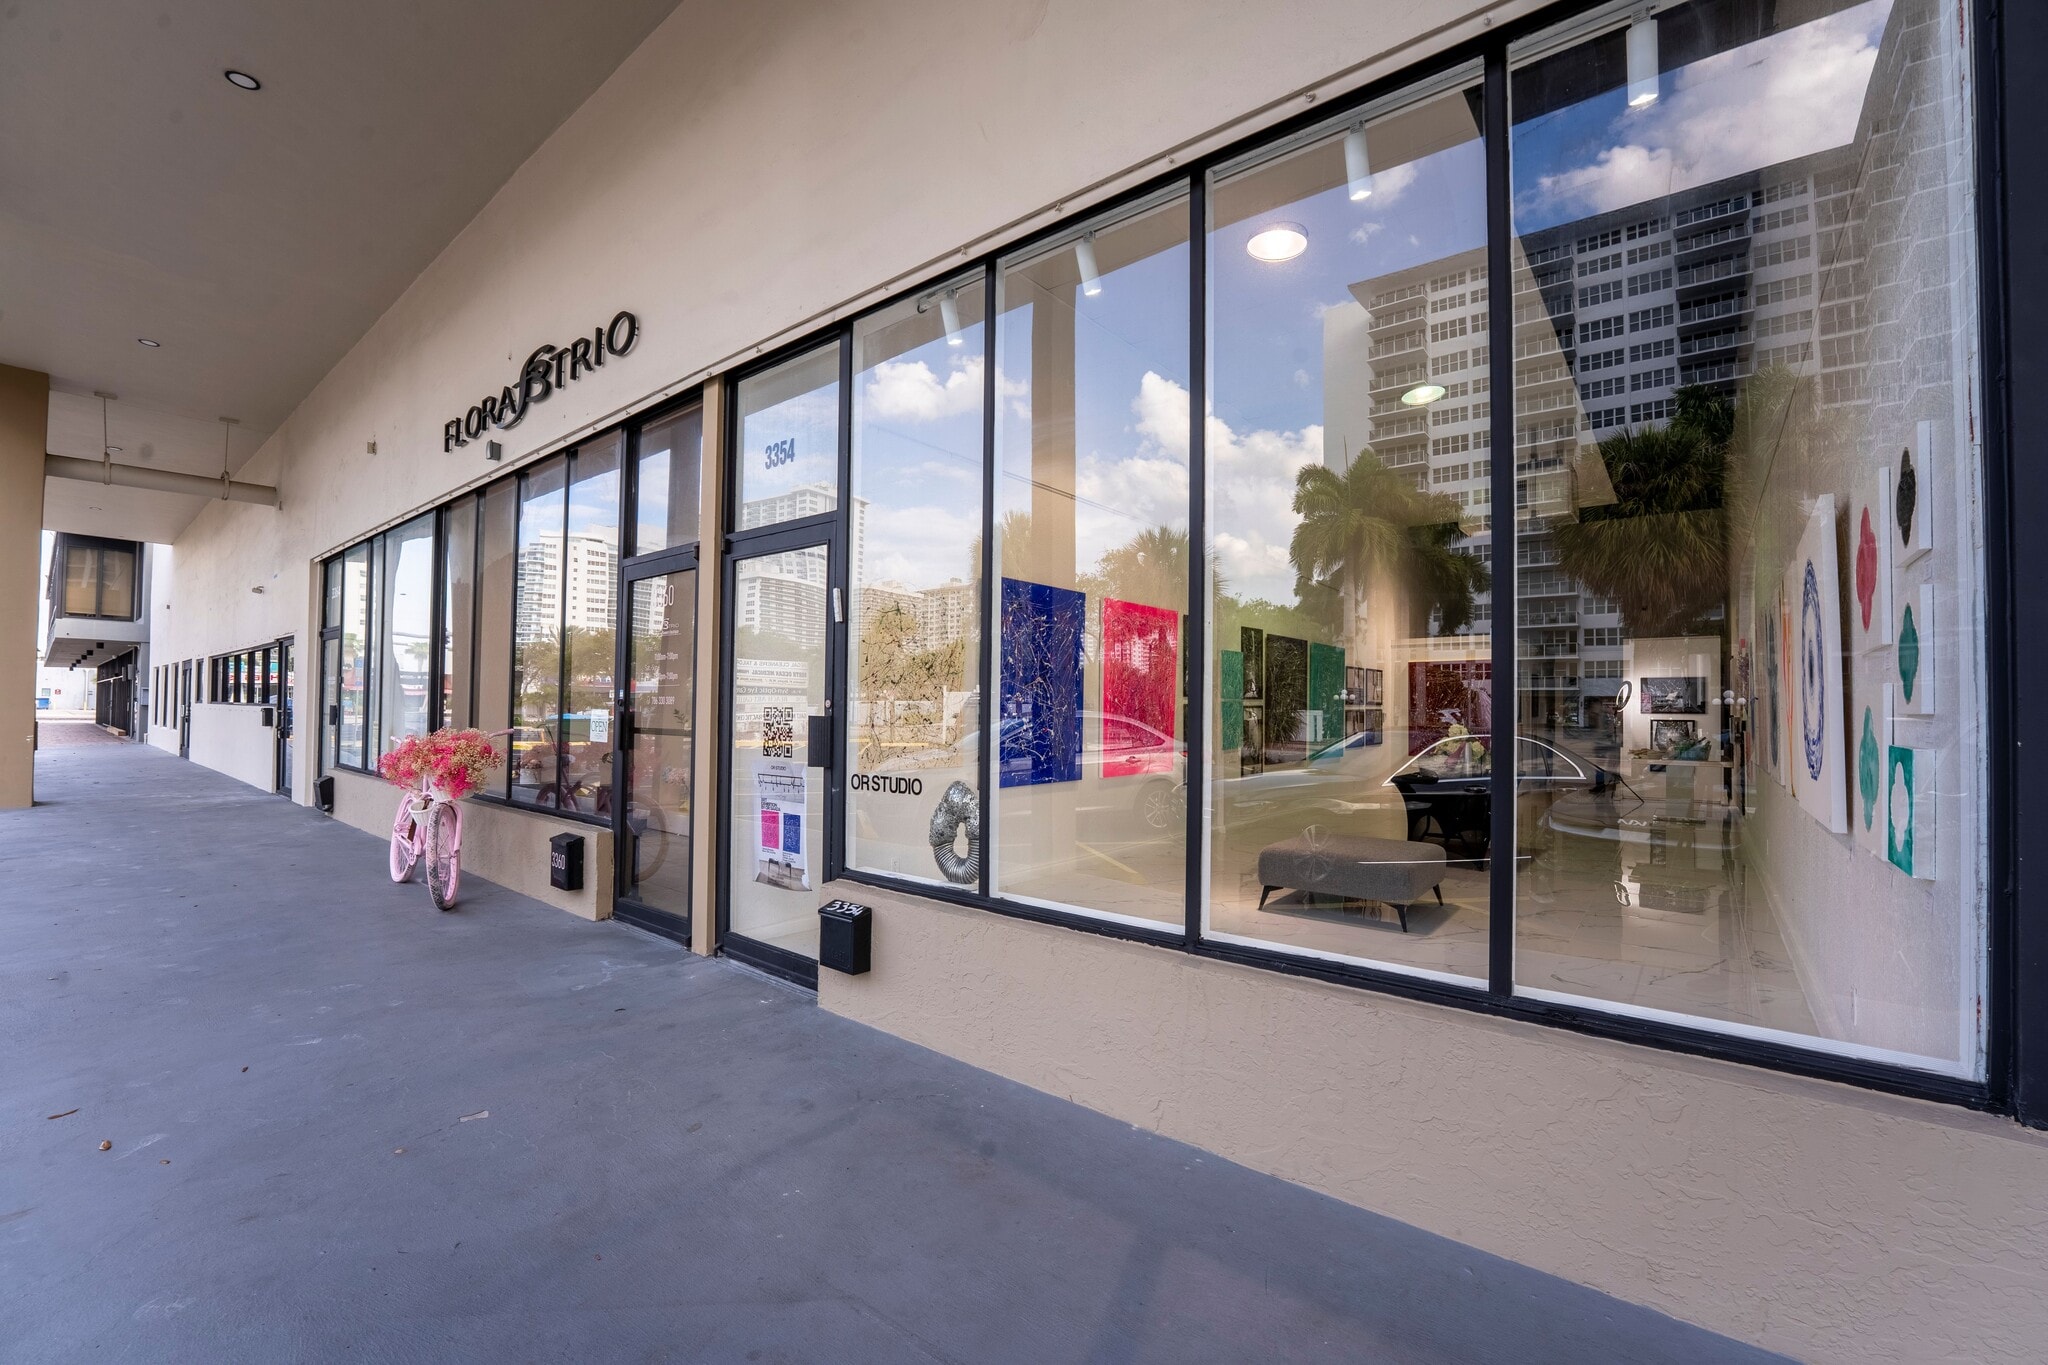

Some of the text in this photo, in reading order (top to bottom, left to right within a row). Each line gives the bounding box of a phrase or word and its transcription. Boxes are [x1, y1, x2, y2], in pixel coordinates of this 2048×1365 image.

[765, 437, 795, 470] 3354
[591, 720, 608, 732] OPEN
[851, 773, 923, 796] OR STUDIO
[551, 851, 566, 870] 3360
[826, 901, 864, 916] 3354
